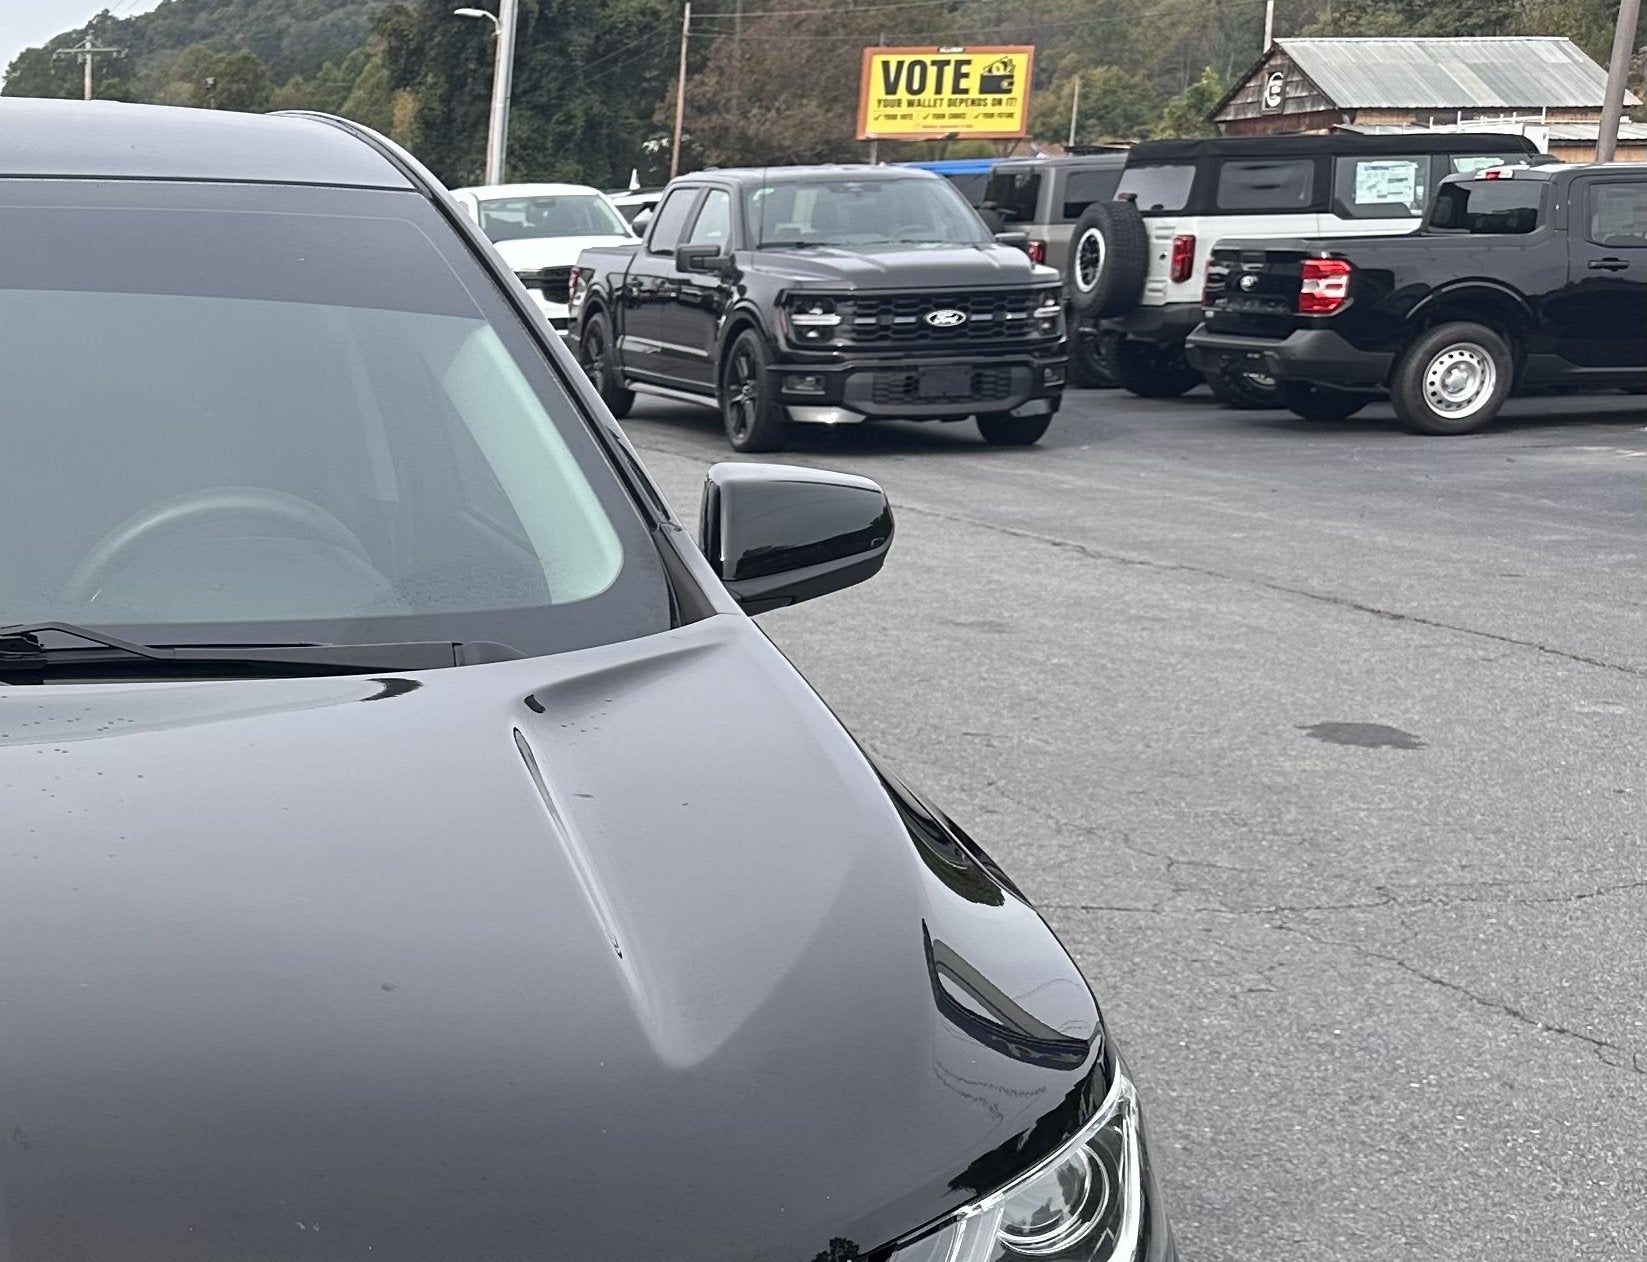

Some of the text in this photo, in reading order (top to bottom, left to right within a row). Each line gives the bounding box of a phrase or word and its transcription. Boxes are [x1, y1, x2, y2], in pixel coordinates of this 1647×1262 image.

[881, 59, 972, 95] VOTE
[877, 98, 902, 108] YOUR
[907, 98, 944, 108] WALLET
[947, 97, 988, 107] DEPENDS
[991, 98, 1003, 106] ON
